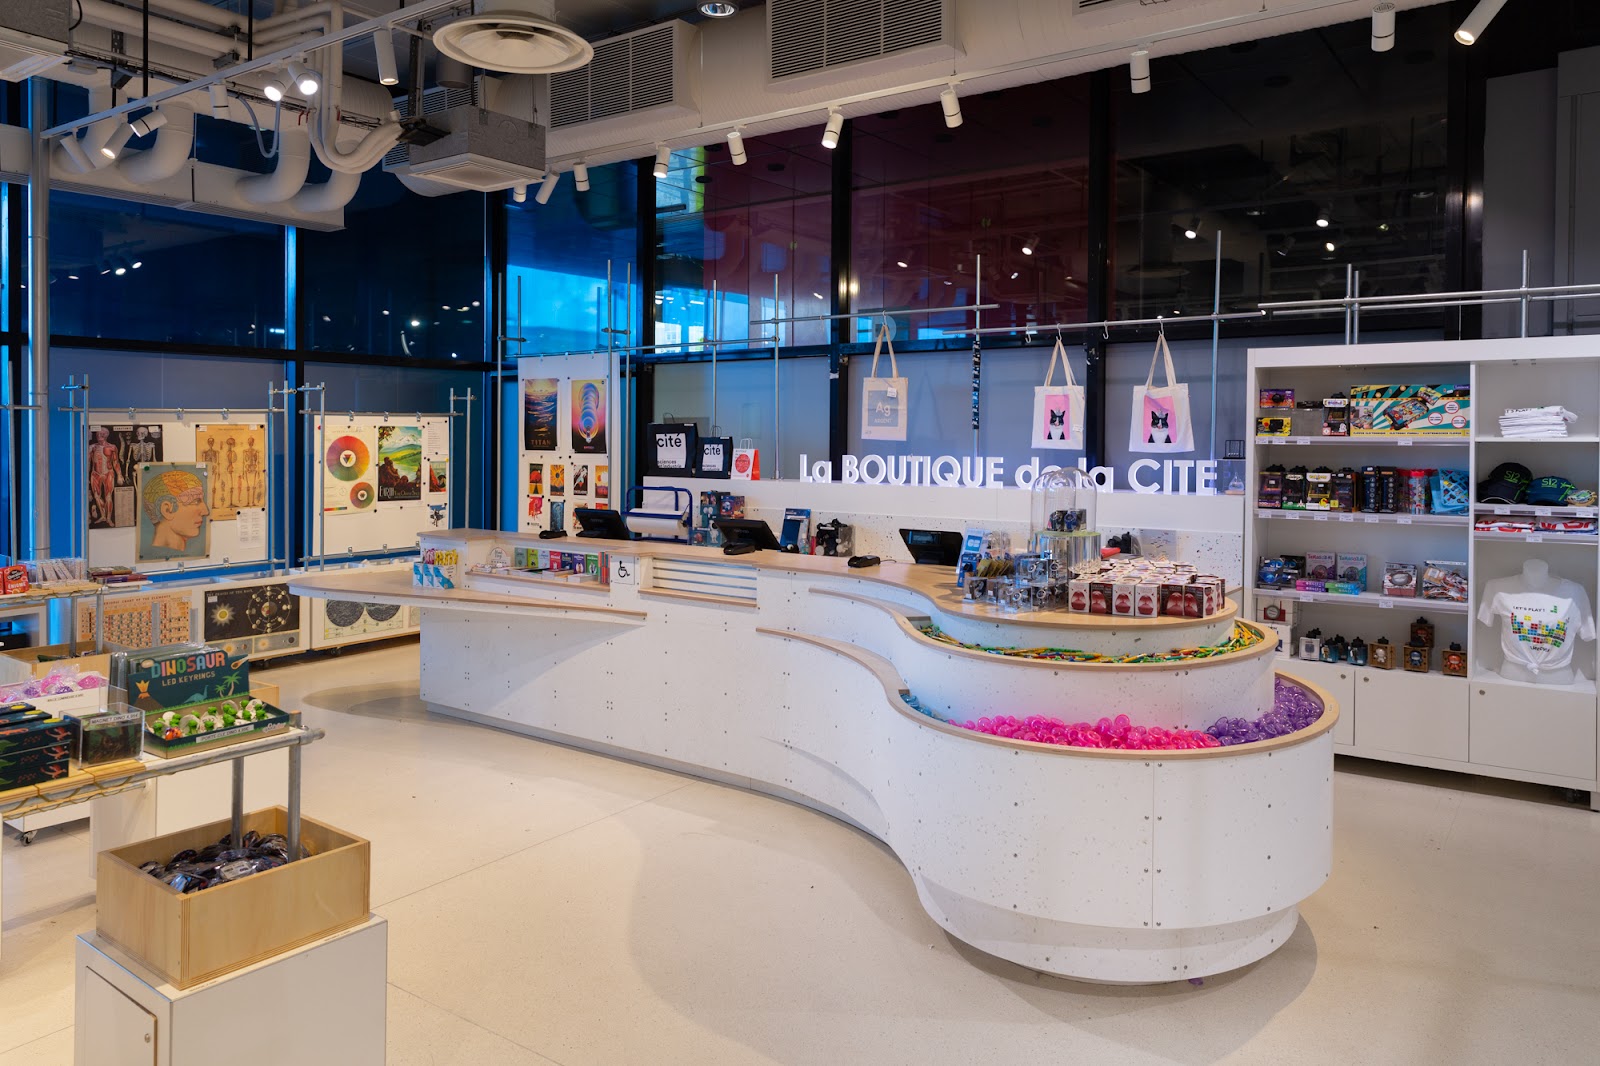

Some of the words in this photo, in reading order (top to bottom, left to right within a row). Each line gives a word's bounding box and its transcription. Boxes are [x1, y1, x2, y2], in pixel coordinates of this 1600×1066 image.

[875, 401, 891, 417] Ag
[656, 433, 682, 448] cité
[703, 443, 721, 455] cité
[799, 454, 832, 484] La
[841, 454, 1004, 489] BOUTIQUE
[1076, 457, 1114, 493] la
[1127, 458, 1218, 496] CITE
[150, 651, 226, 679] DINOSAUR
[161, 679, 177, 687] LED
[178, 670, 216, 684] KEYRINGS
